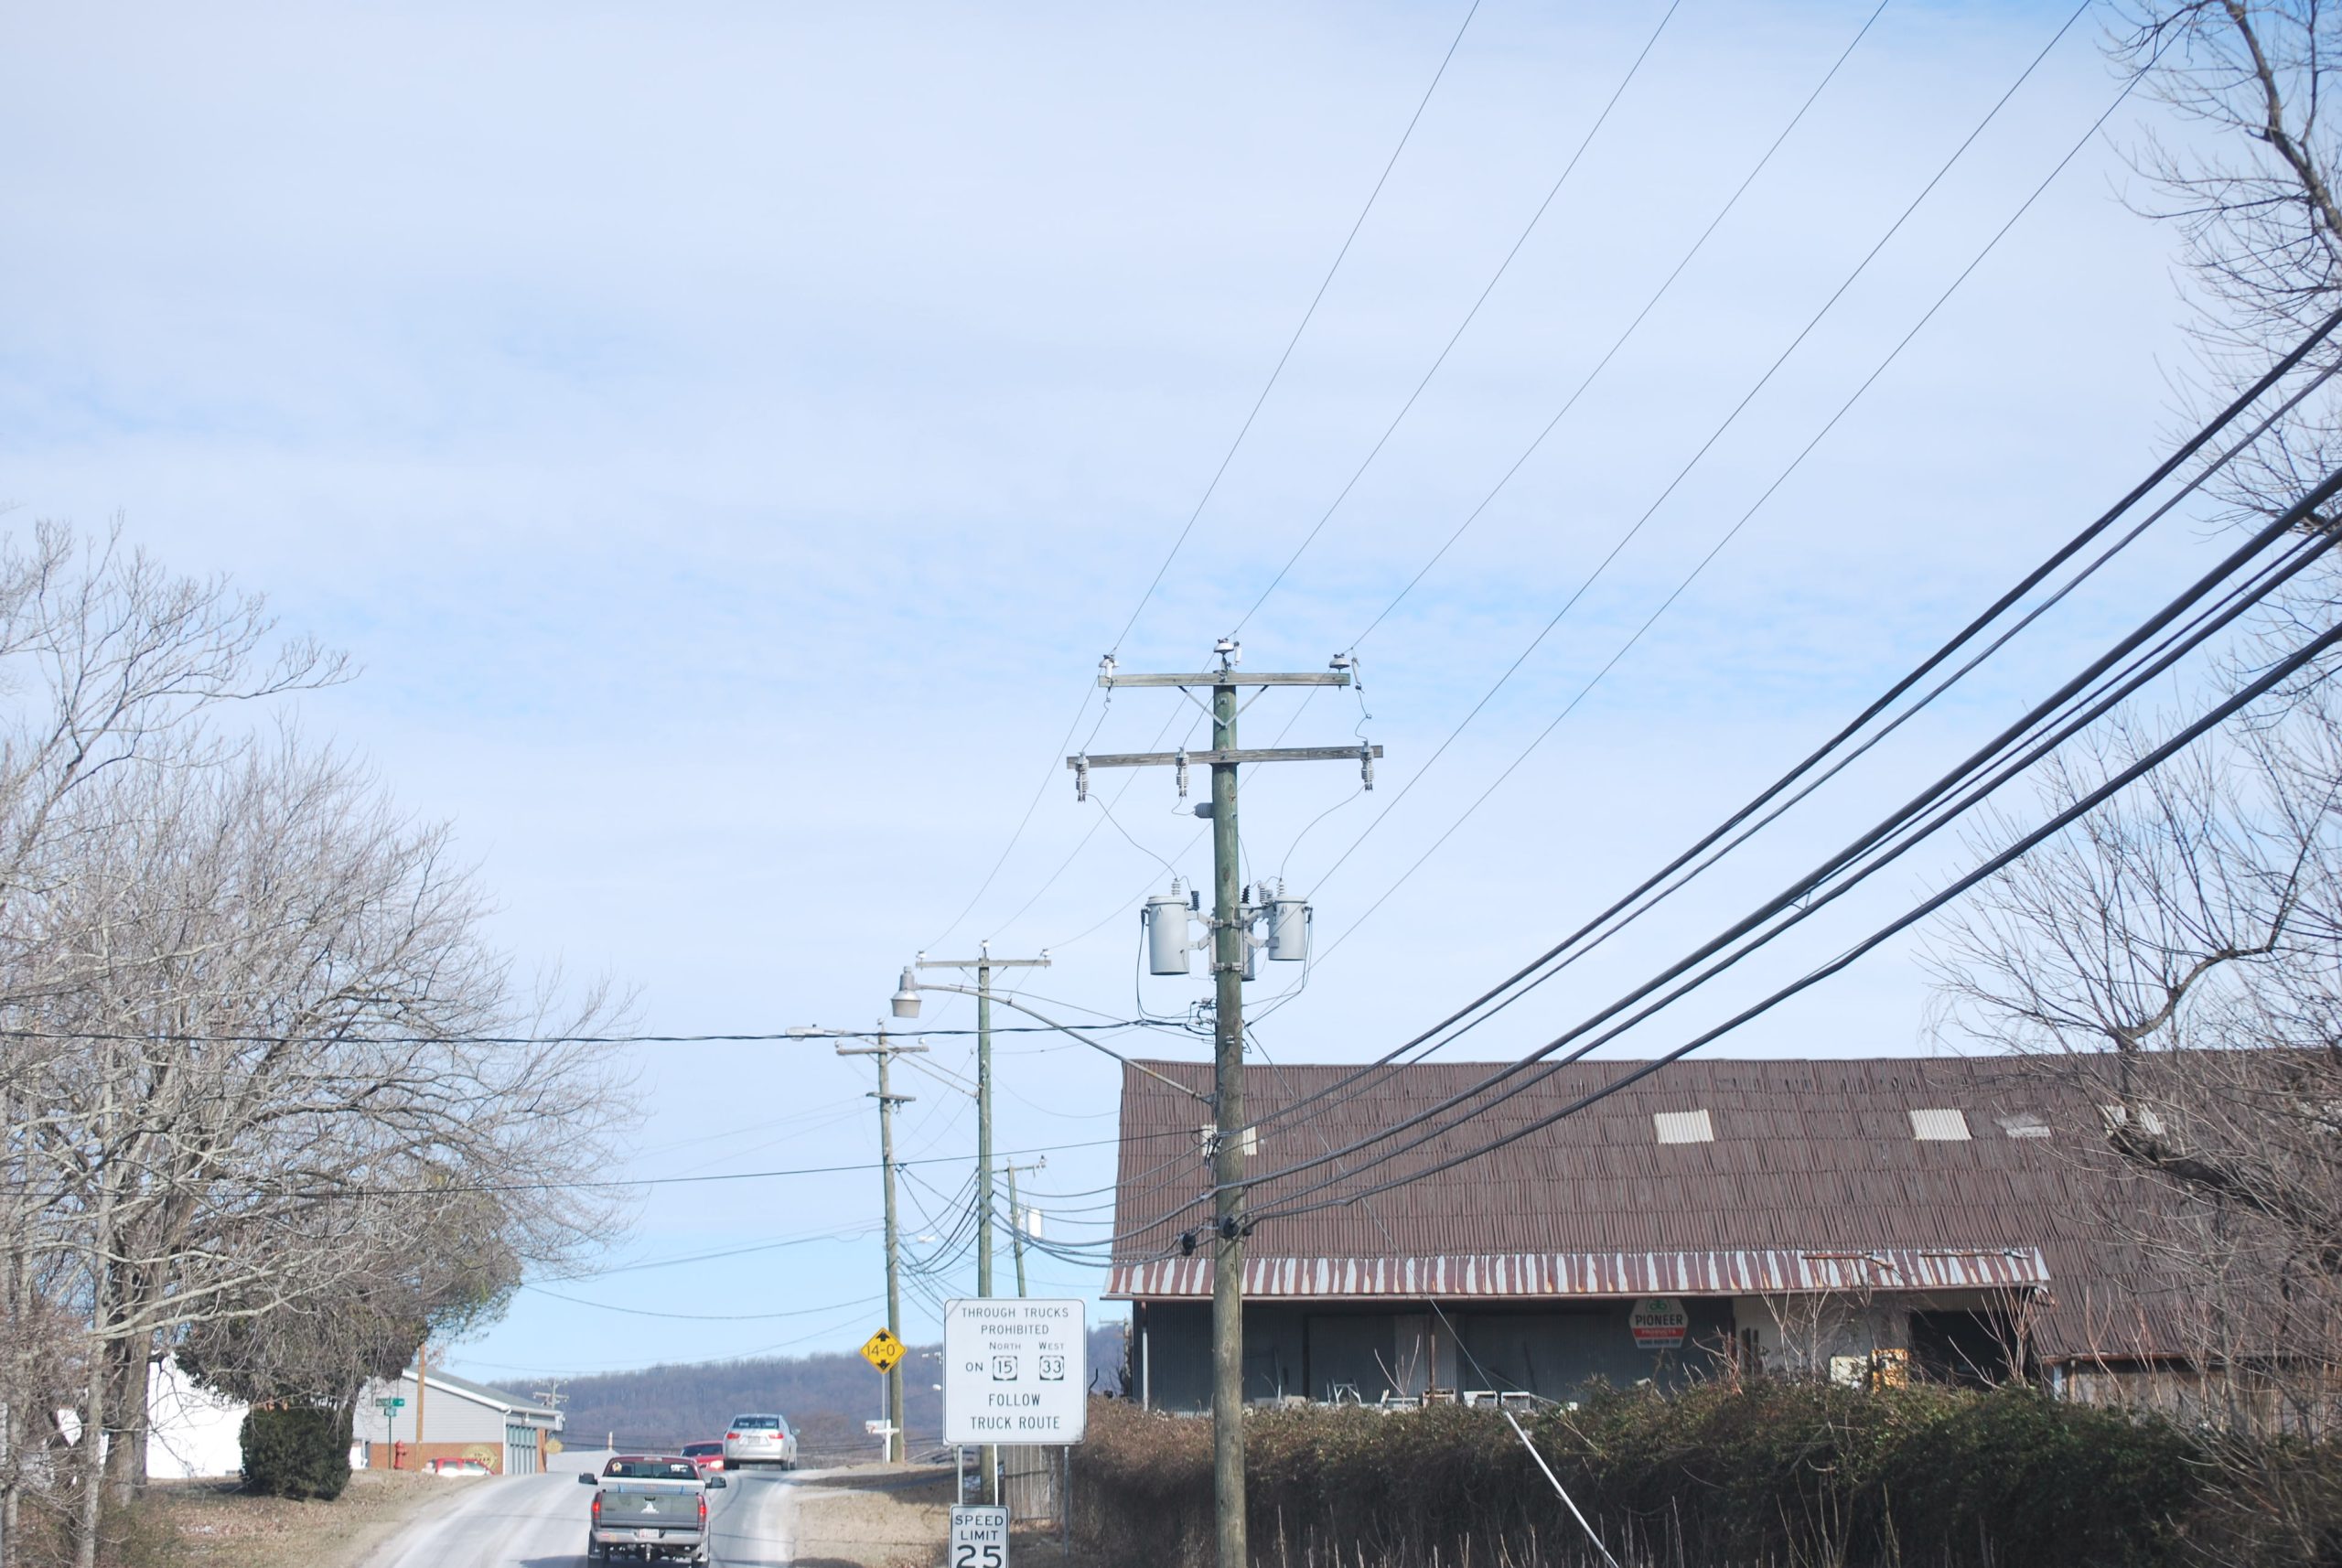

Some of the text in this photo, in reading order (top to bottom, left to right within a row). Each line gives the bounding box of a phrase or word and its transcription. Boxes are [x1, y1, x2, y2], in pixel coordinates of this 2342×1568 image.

[962, 1307, 1069, 1317] THROUGH TRUCKS
[1635, 1314, 1683, 1326] PIONEER
[981, 1325, 1049, 1335] PROHIBITED
[965, 1360, 1061, 1374] ON 15 33
[988, 1393, 1040, 1406] FOLLOW
[971, 1416, 1059, 1430] TRUCK ROUTE
[955, 1515, 1004, 1526] SPEED
[961, 1530, 998, 1541] LIMIT
[956, 1544, 1002, 1568] 25
